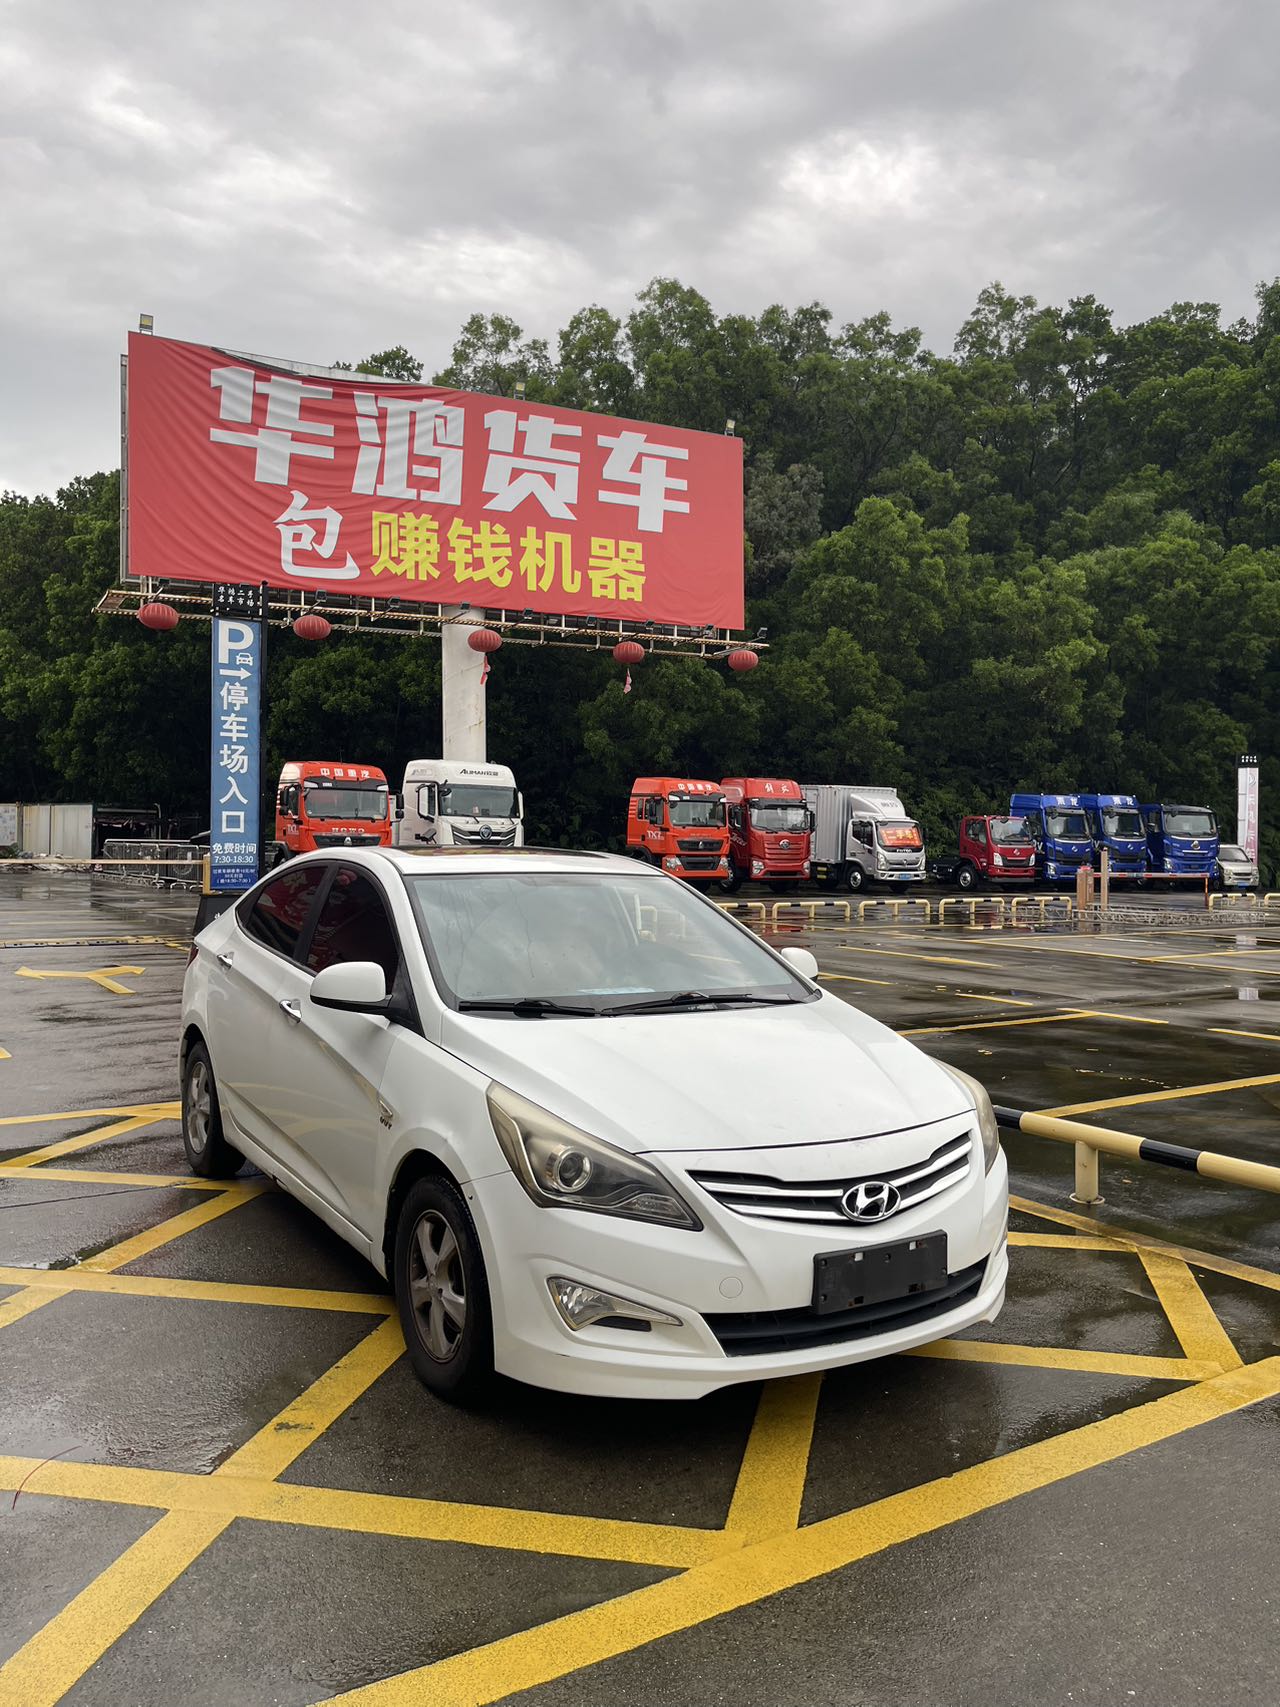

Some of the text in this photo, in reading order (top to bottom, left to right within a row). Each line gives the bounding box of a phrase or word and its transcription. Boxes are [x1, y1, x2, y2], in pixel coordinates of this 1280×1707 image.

[210, 366, 690, 532] 华鸿货车
[218, 620, 254, 664] P
[219, 681, 249, 834] 停车场入口
[212, 842, 257, 854] 免费时间
